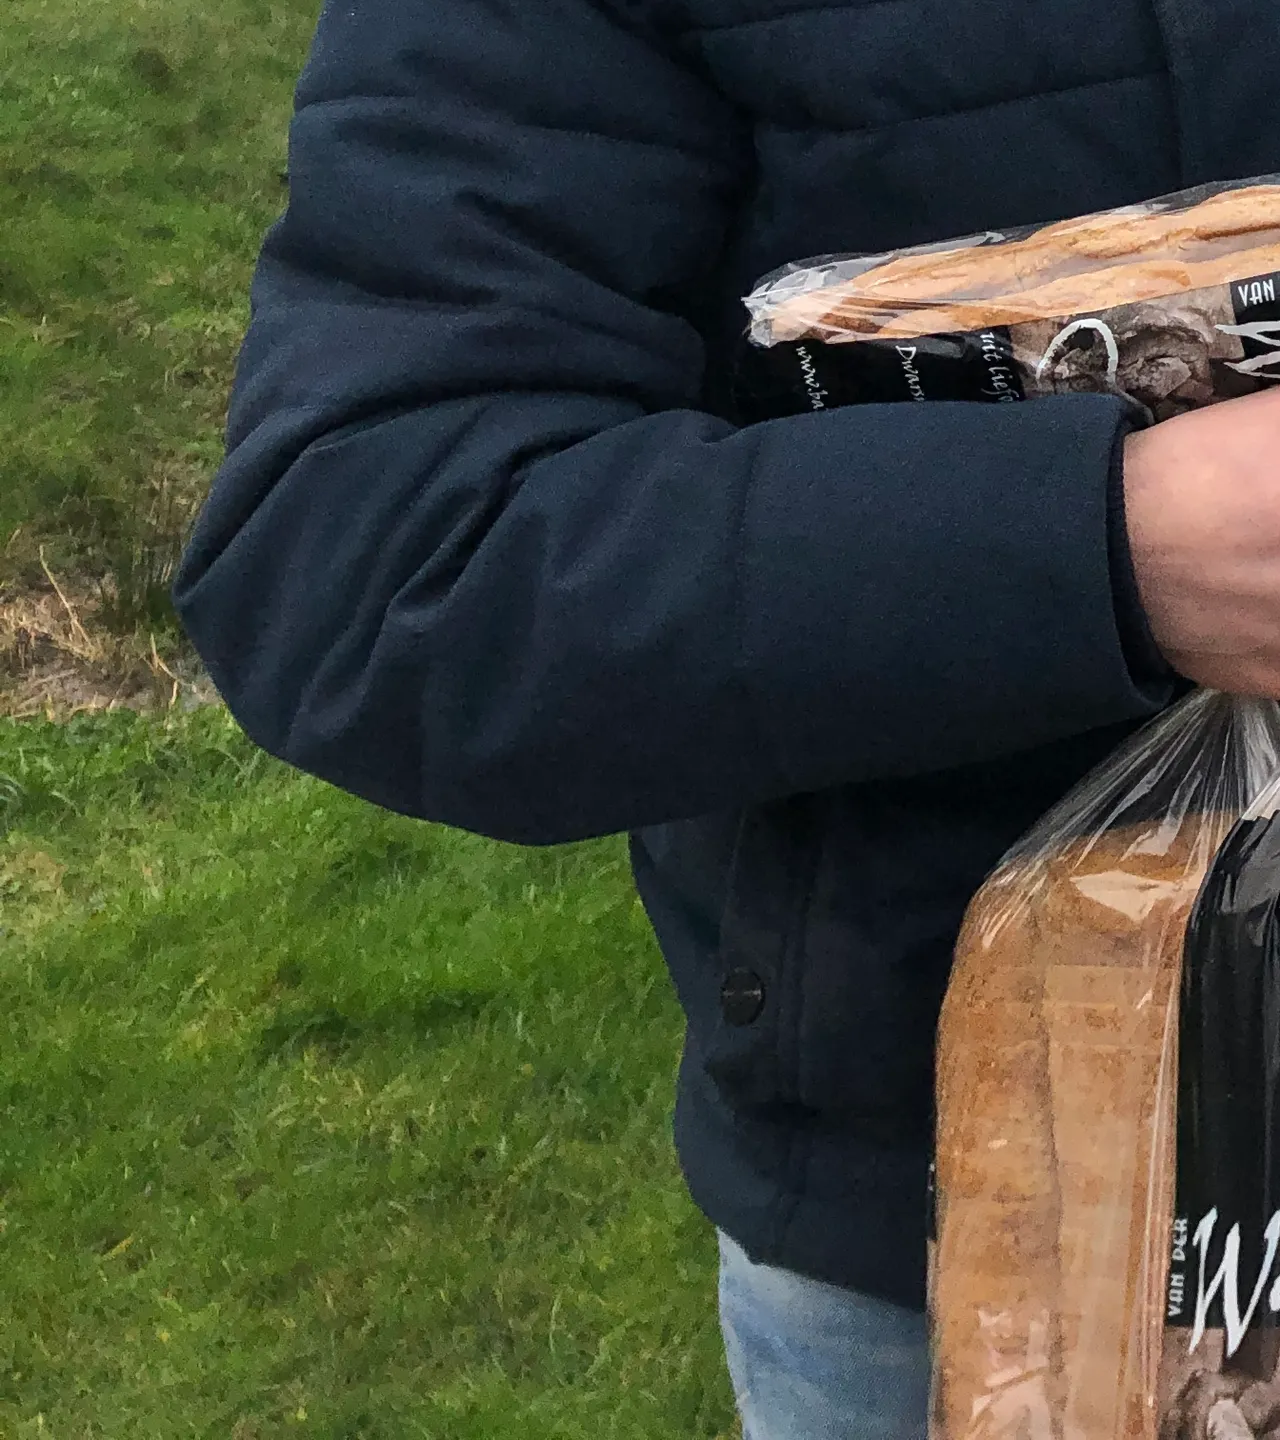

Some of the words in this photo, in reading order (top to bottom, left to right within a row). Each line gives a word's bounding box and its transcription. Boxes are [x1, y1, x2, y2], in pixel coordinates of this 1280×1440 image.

[1237, 279, 1276, 307] VAN
[1171, 1216, 1189, 1262] DER
[1167, 1273, 1186, 1318] VAN
